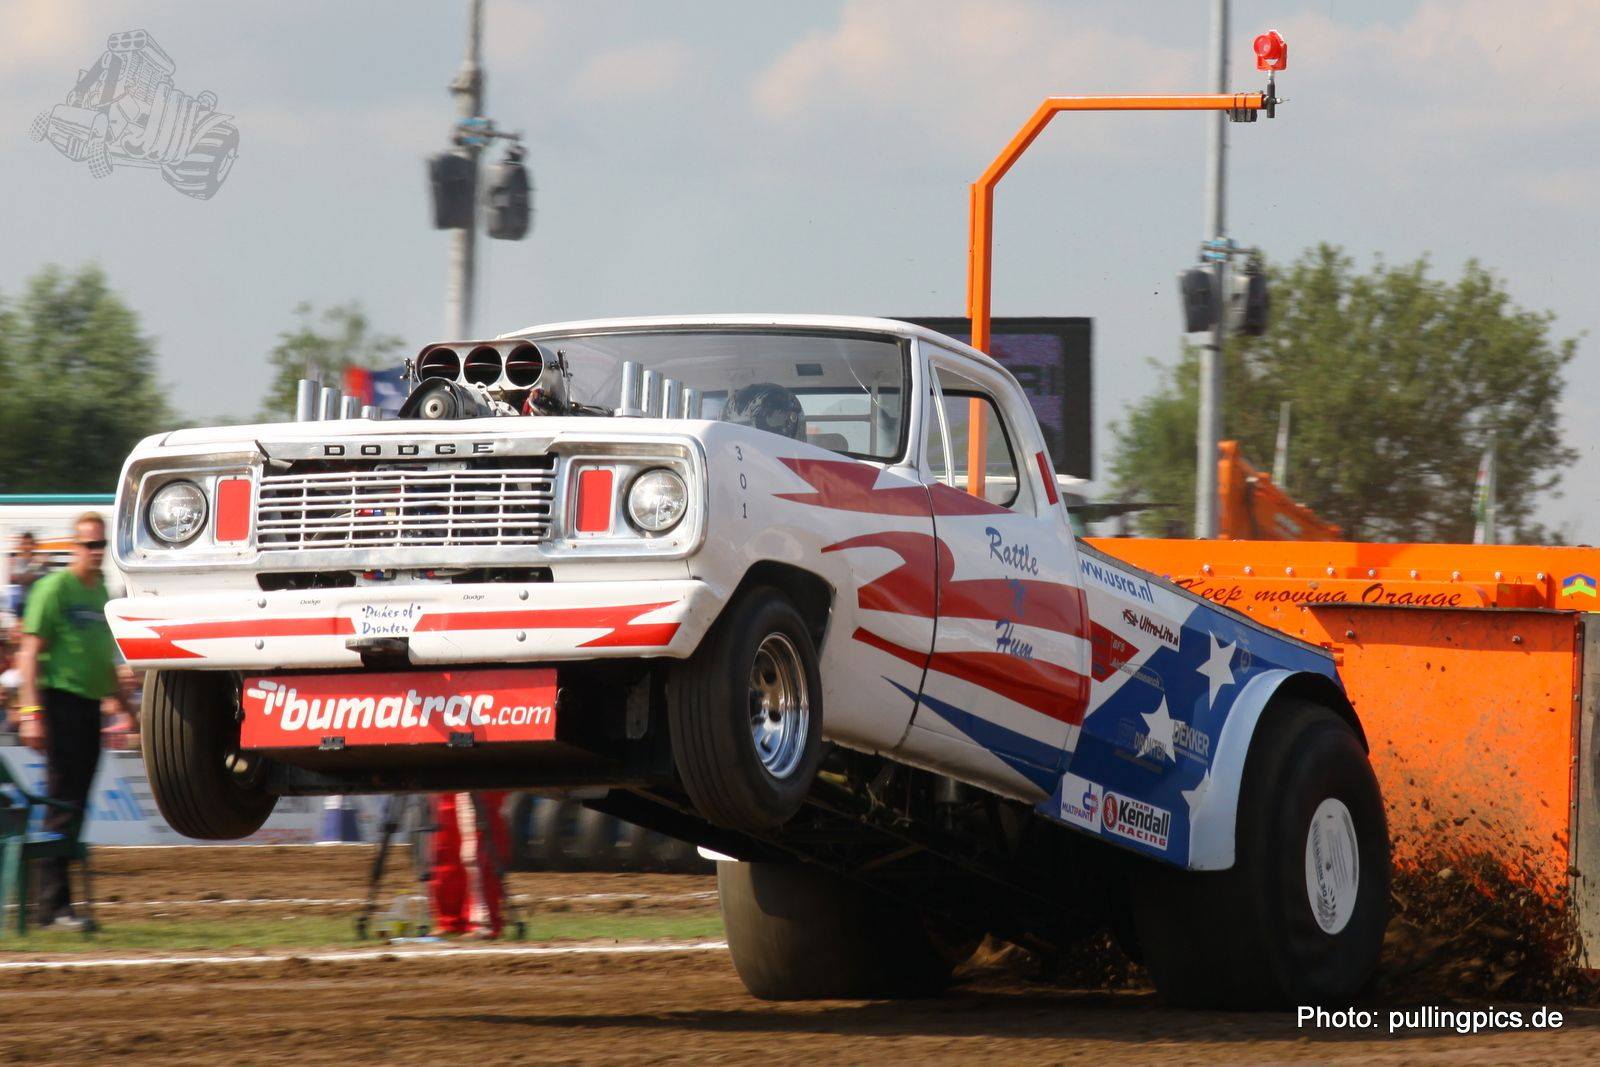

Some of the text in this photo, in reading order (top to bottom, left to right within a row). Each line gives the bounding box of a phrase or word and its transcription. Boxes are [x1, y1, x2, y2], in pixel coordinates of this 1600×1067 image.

[323, 442, 495, 456] DODGE
[985, 526, 1039, 576] Rattle
[462, 593, 485, 601] Dodge
[1080, 559, 1154, 603] ww.usra.nl
[1175, 578, 1462, 606] Keep moving Orange
[995, 618, 1034, 661] Hum
[280, 688, 551, 731] bumatrac.com
[1118, 799, 1170, 837] Kendall
[1131, 801, 1150, 813] TEAM
[1117, 823, 1167, 847] RACING
